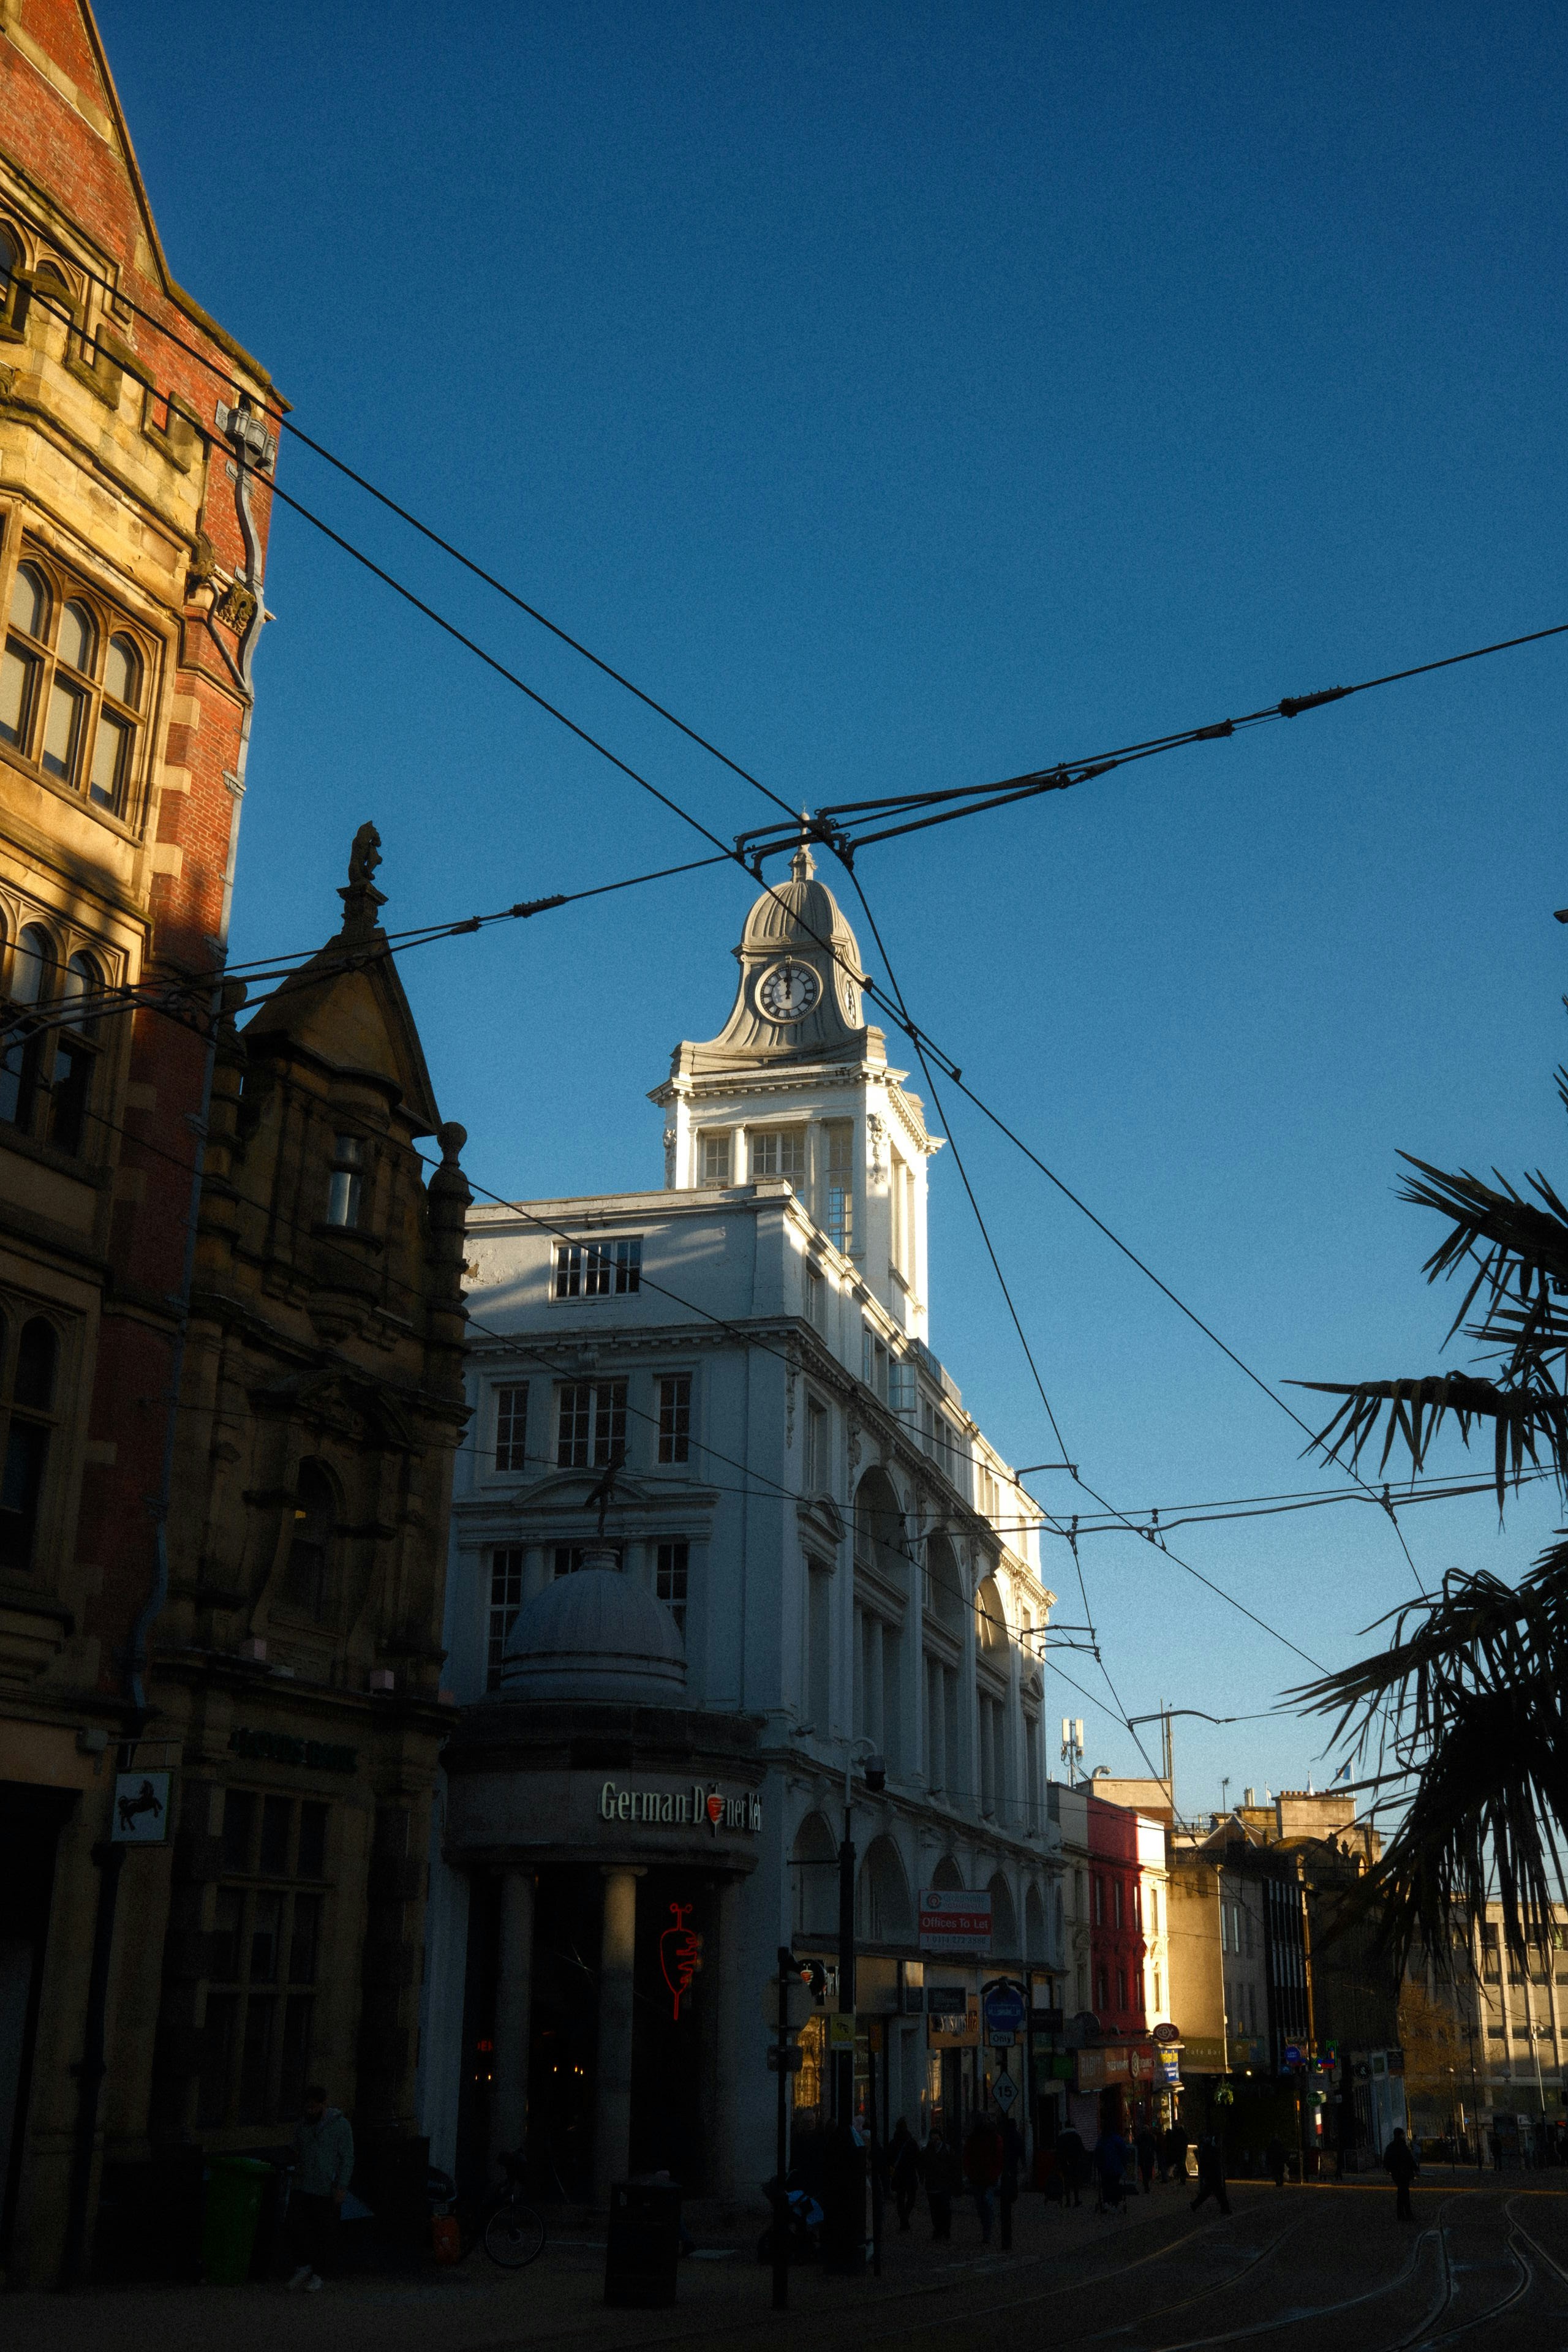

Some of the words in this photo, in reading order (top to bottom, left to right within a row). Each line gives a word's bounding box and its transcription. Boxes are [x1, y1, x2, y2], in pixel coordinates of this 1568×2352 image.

[601, 1781, 686, 1823] German
[922, 1917, 957, 1928] Offices
[959, 1918, 971, 1929] To
[973, 1918, 988, 1929] Let
[992, 2034, 1011, 2043] Only
[998, 2086, 1012, 2098] 15
